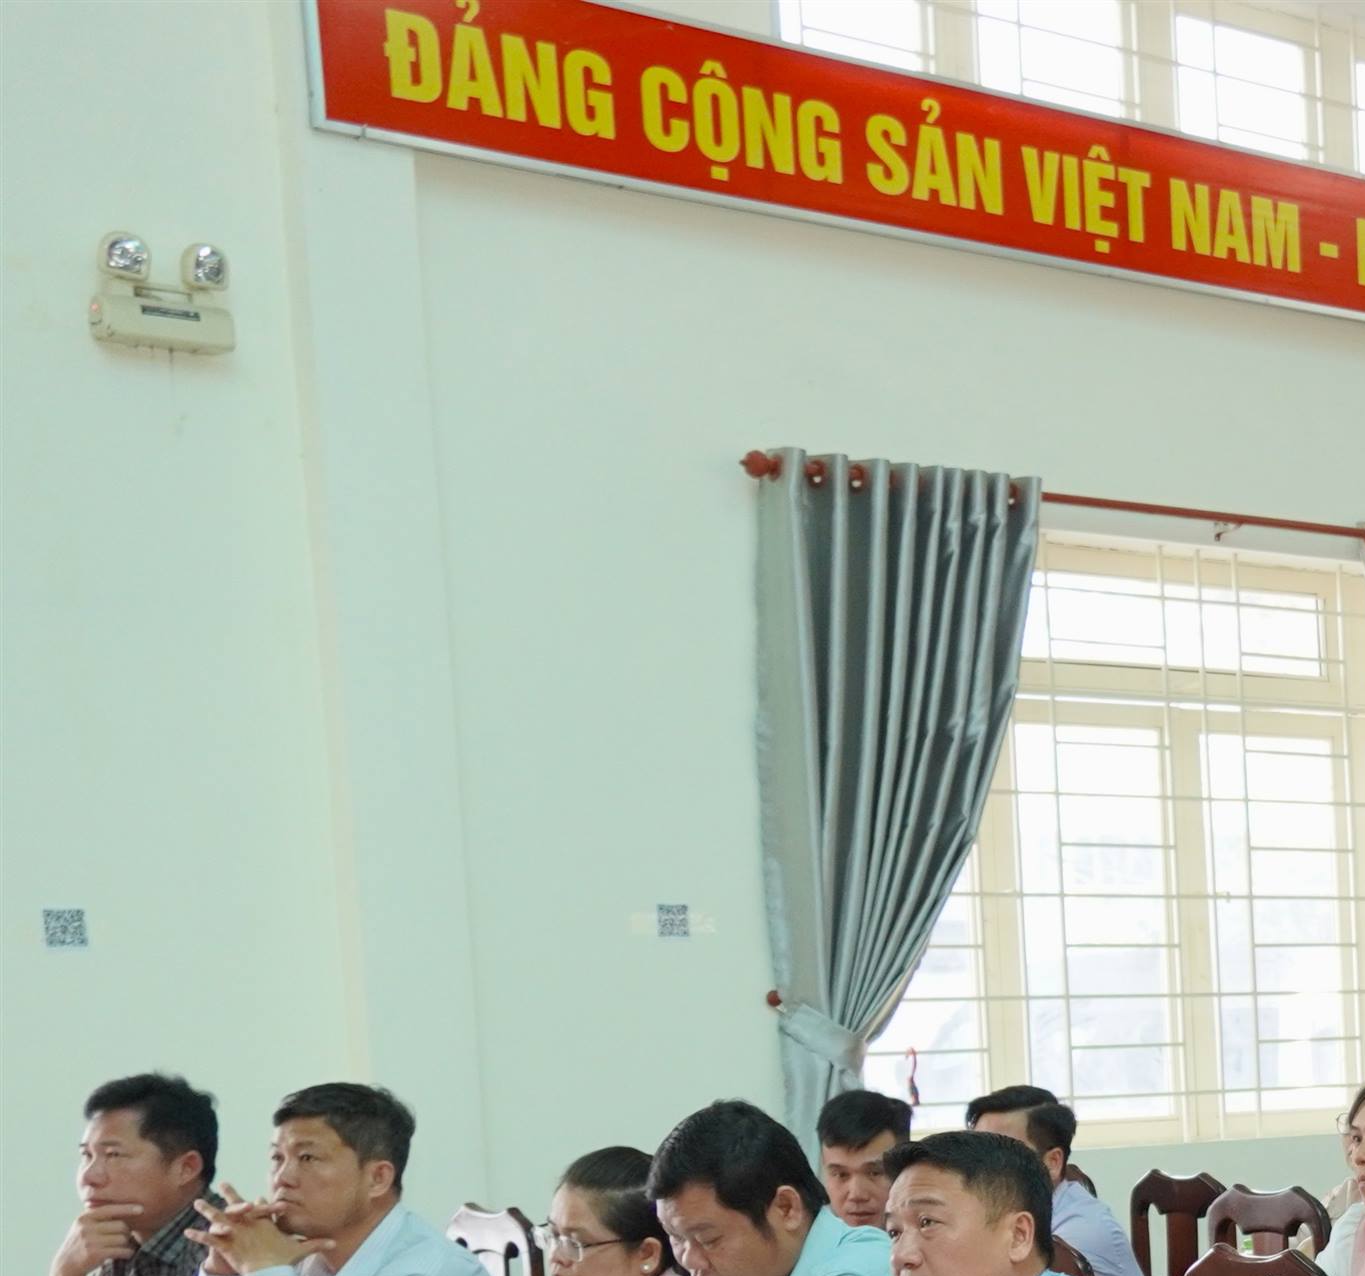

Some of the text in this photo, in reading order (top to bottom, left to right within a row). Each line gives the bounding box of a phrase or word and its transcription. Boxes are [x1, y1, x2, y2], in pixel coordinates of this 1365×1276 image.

[384, 0, 615, 139] ĐẢNG
[640, 60, 843, 184] CỘNG
[865, 98, 1003, 215] SẢN
[1021, 145, 1150, 253] VIỆT
[1170, 177, 1301, 272] NAM
[1319, 242, 1339, 259] -
